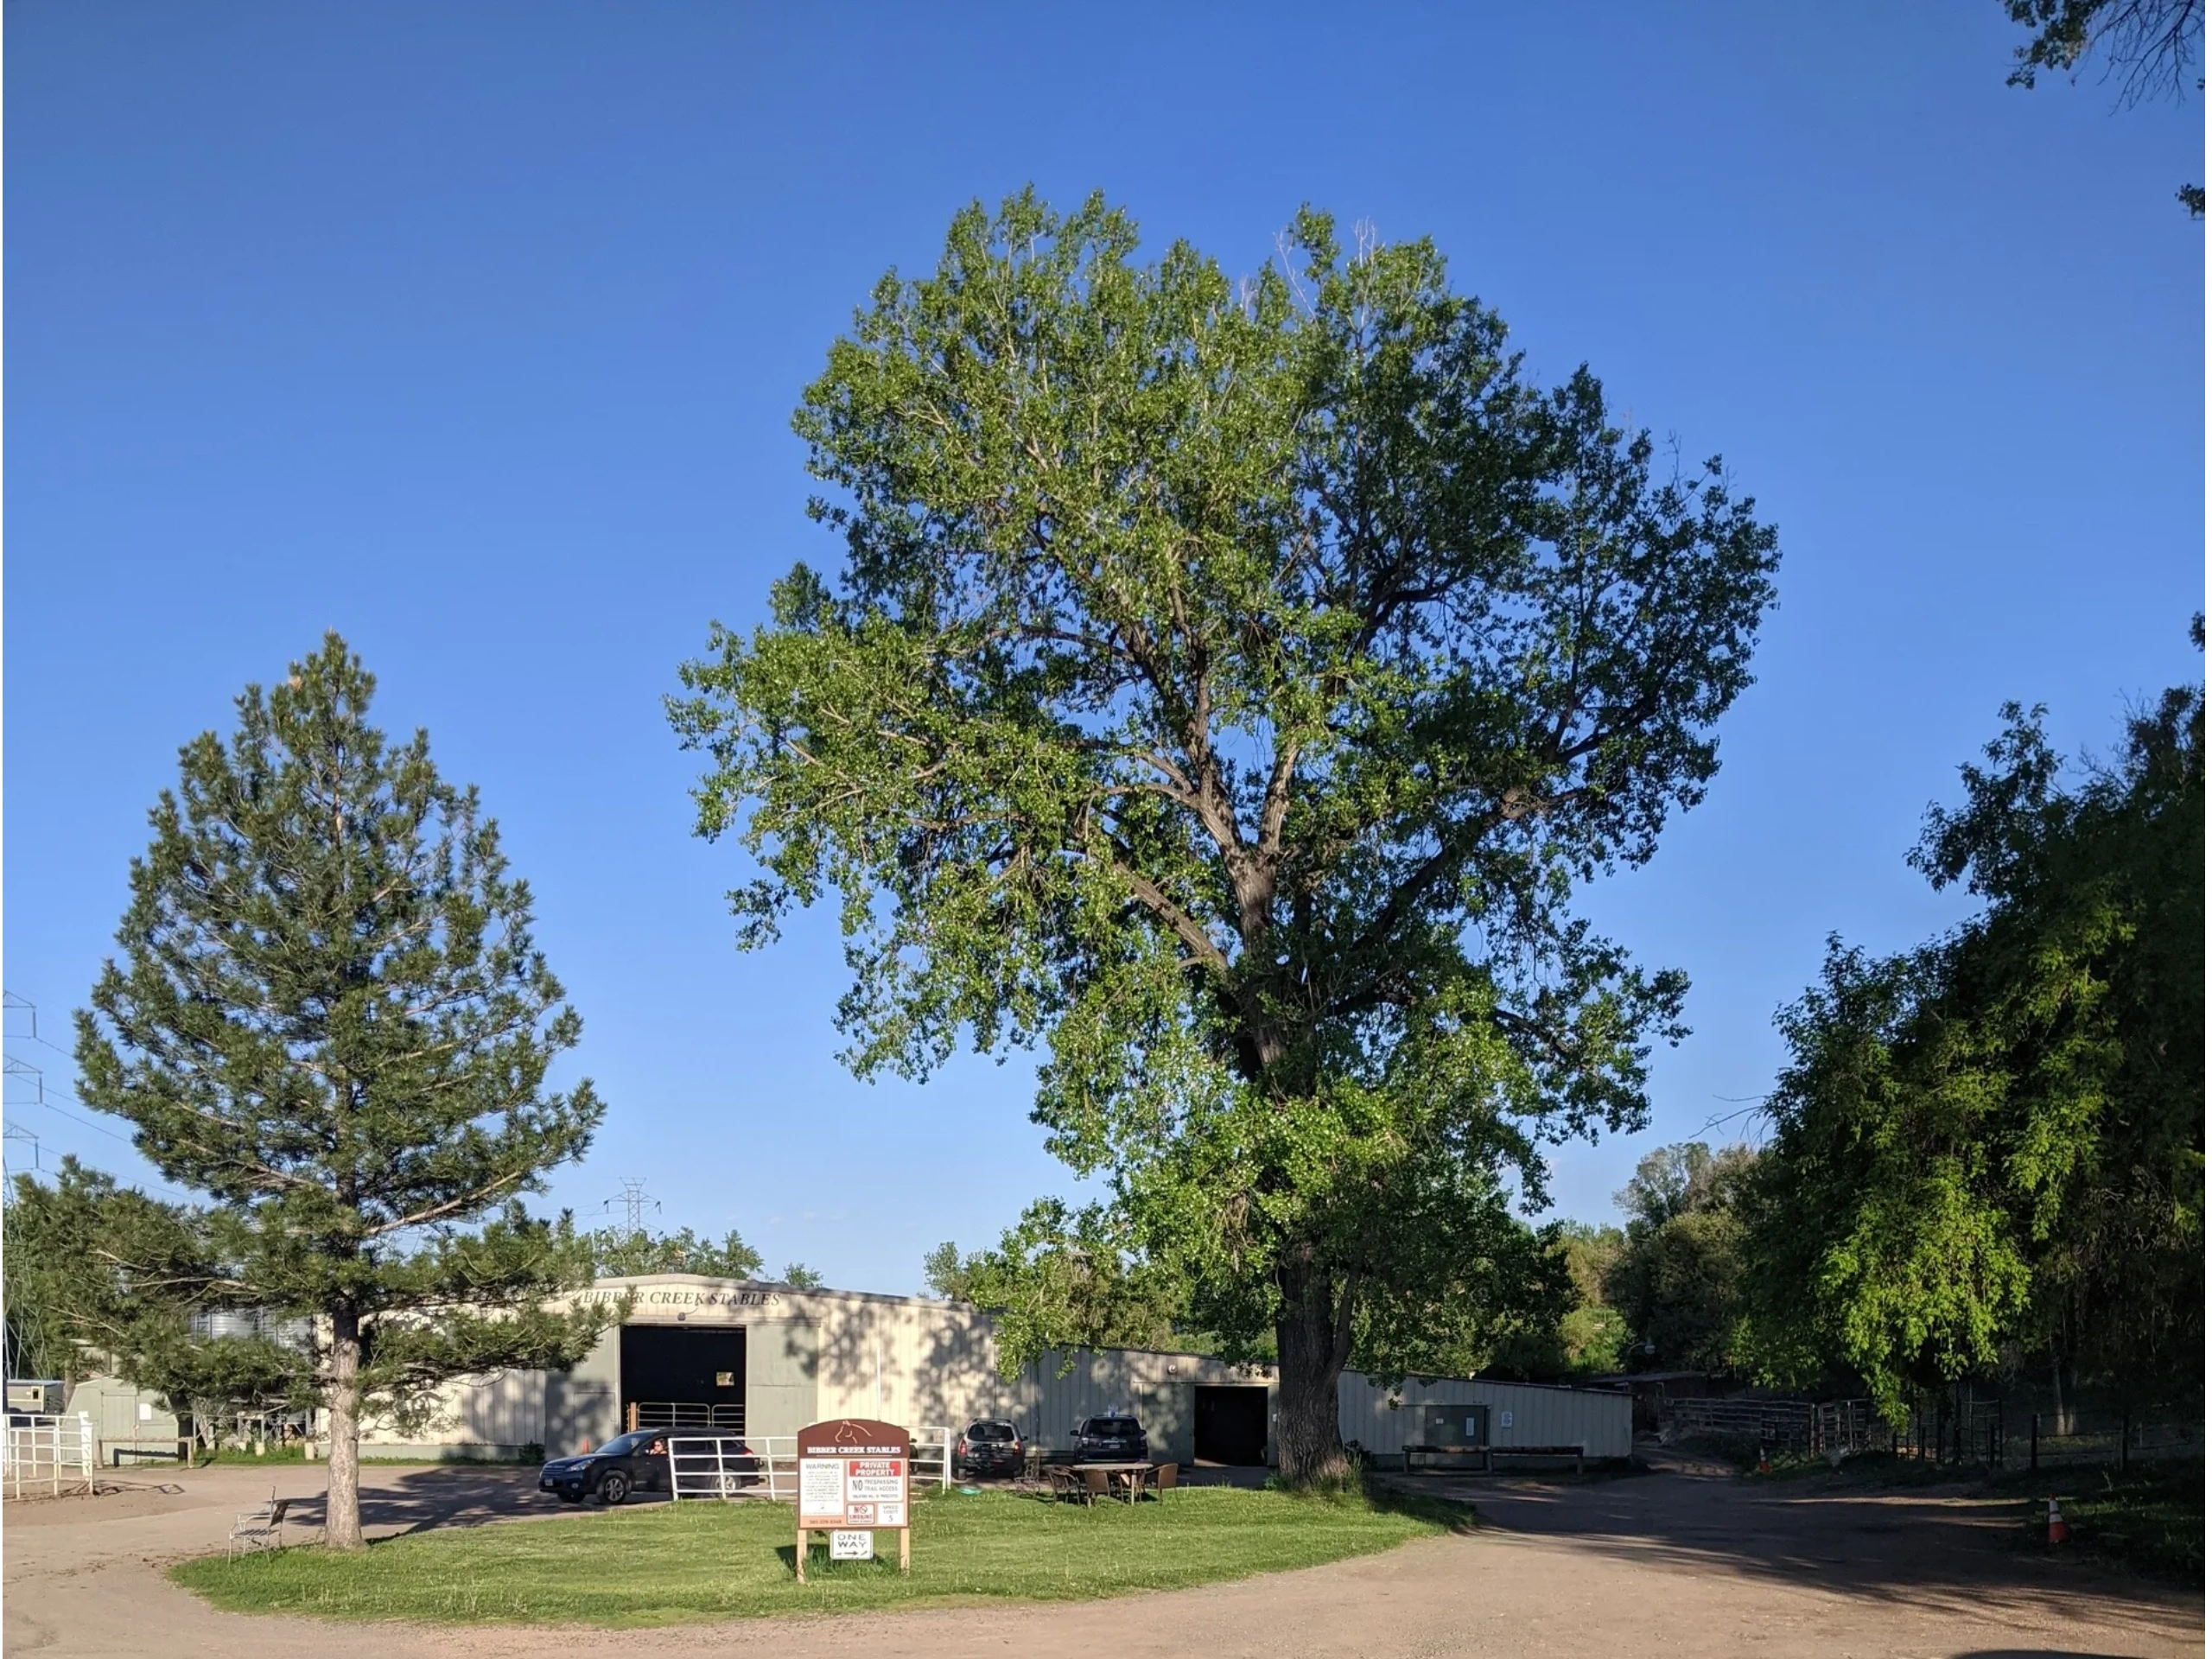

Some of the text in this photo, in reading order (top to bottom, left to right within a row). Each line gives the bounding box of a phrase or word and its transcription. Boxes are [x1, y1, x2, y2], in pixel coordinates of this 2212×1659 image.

[650, 1292, 705, 1305] CREEK
[709, 1294, 781, 1306] STABLES
[852, 1479, 863, 1491] NO
